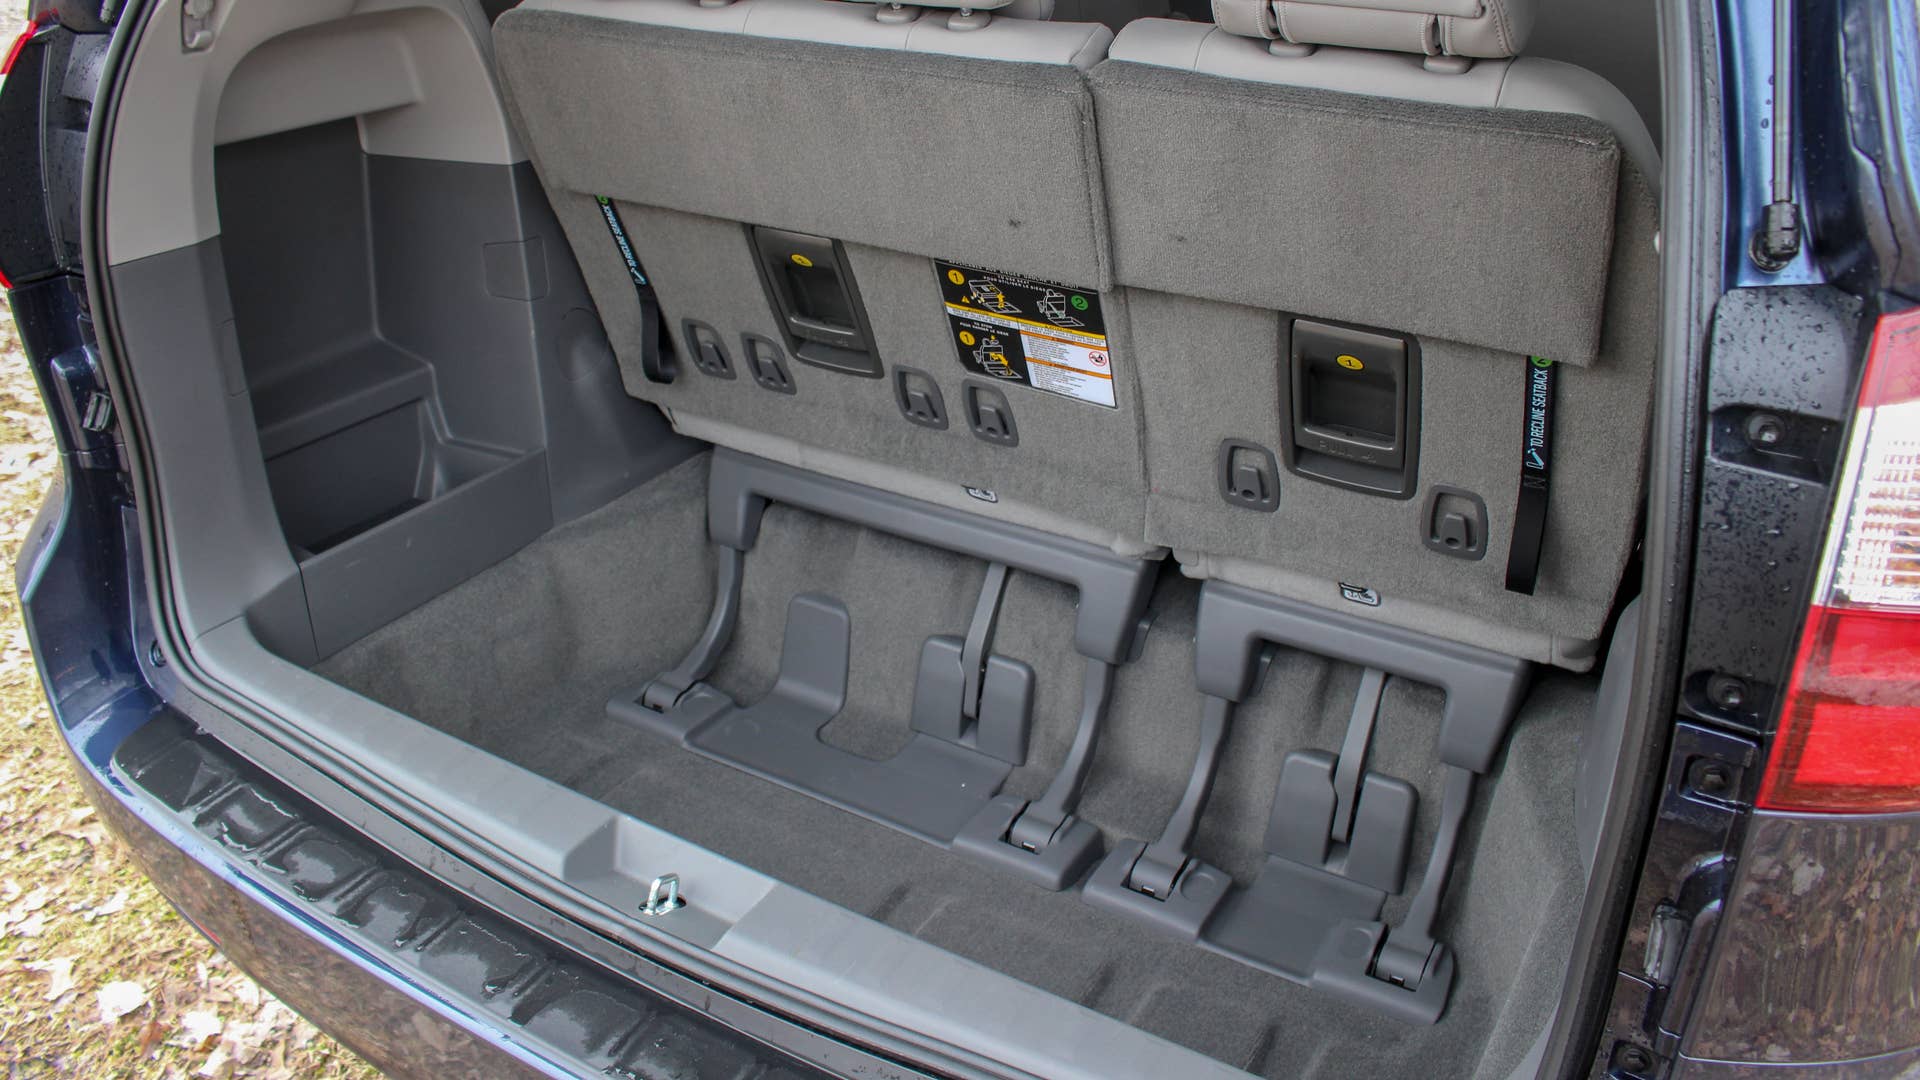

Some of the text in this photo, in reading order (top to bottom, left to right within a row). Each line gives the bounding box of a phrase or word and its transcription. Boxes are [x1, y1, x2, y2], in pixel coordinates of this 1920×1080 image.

[1532, 368, 1549, 408] SEATBACK
[1530, 408, 1546, 439] RECLINE
[1530, 439, 1544, 448] TO
